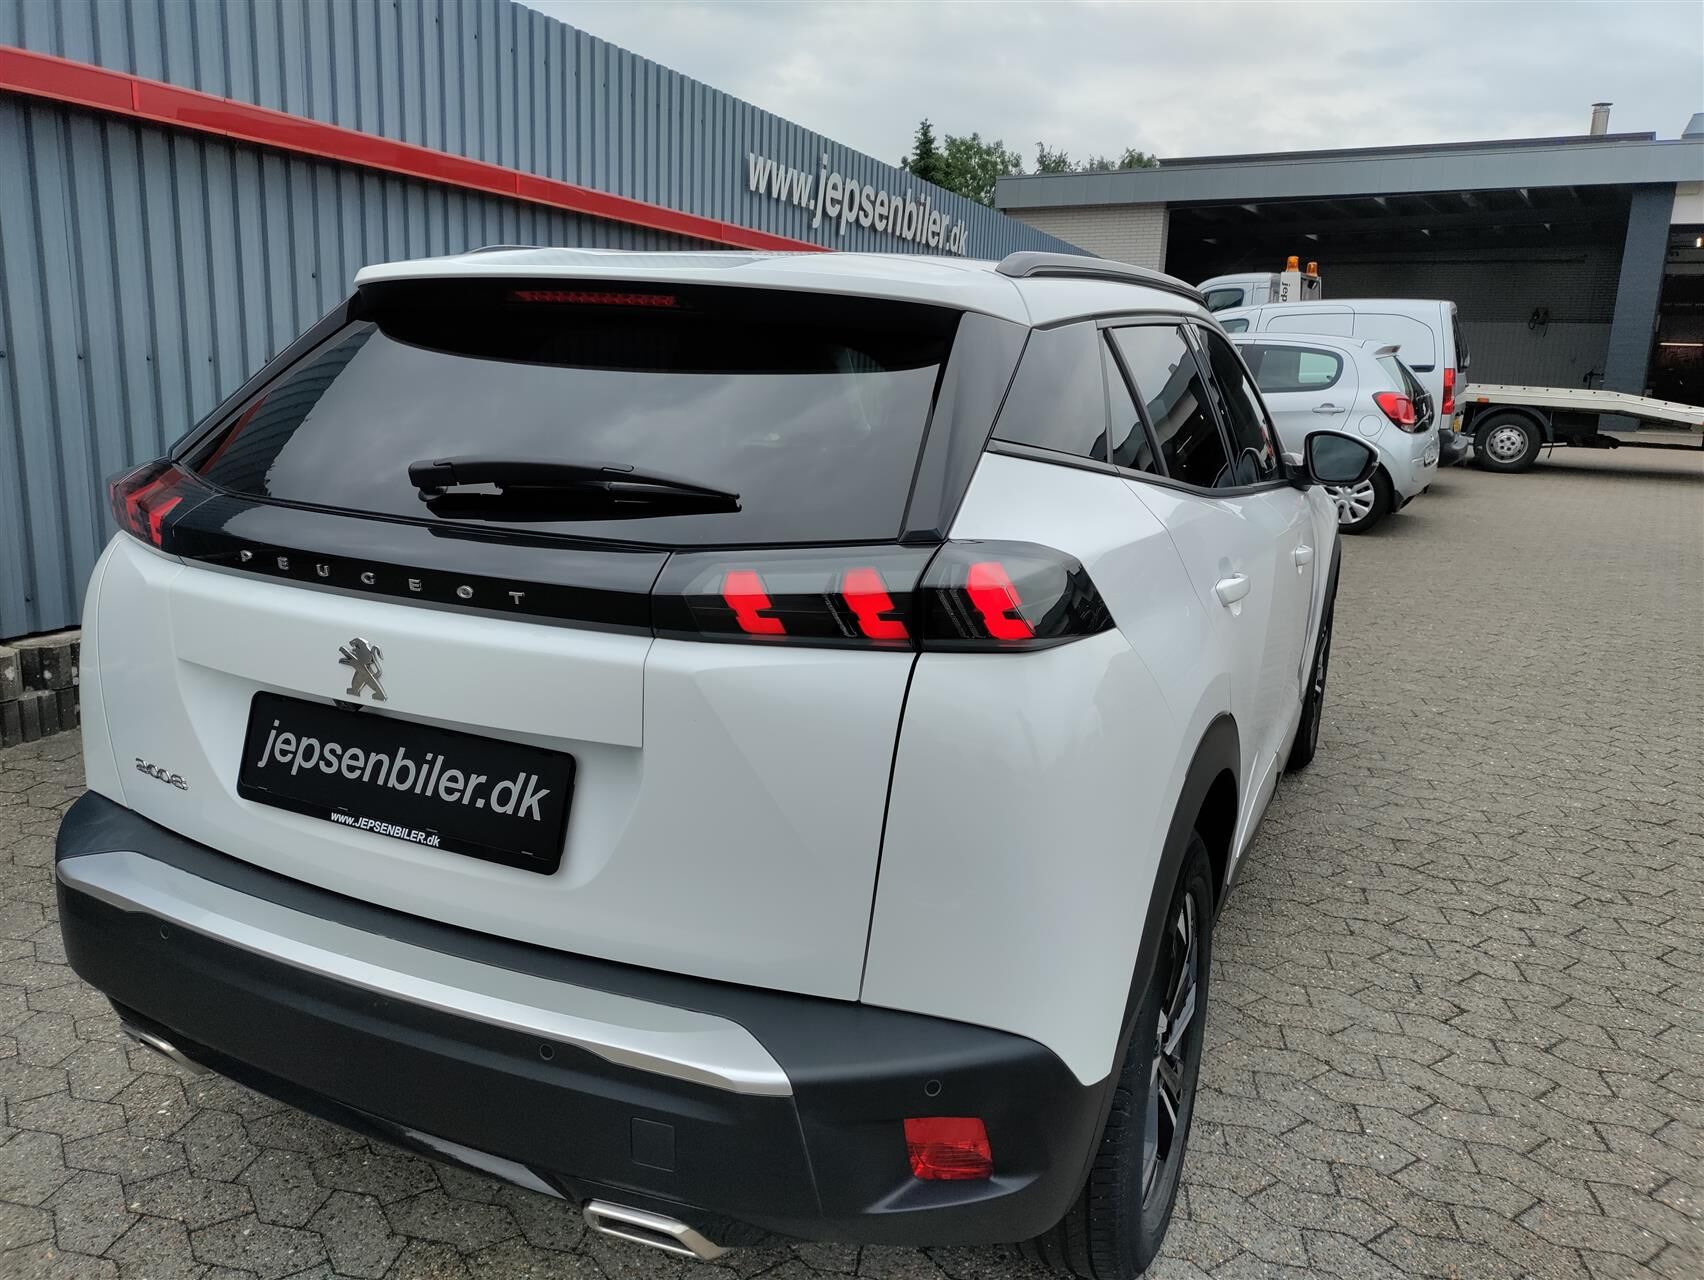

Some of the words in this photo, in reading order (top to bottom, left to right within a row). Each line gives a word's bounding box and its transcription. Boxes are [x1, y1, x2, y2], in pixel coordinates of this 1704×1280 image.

[749, 152, 969, 256] www.jepsenbiler.dk
[239, 550, 526, 604] PEUGEOT
[257, 719, 551, 821] jepsenbiler.dk
[330, 811, 441, 847] www.JEPSENBILER.dk
